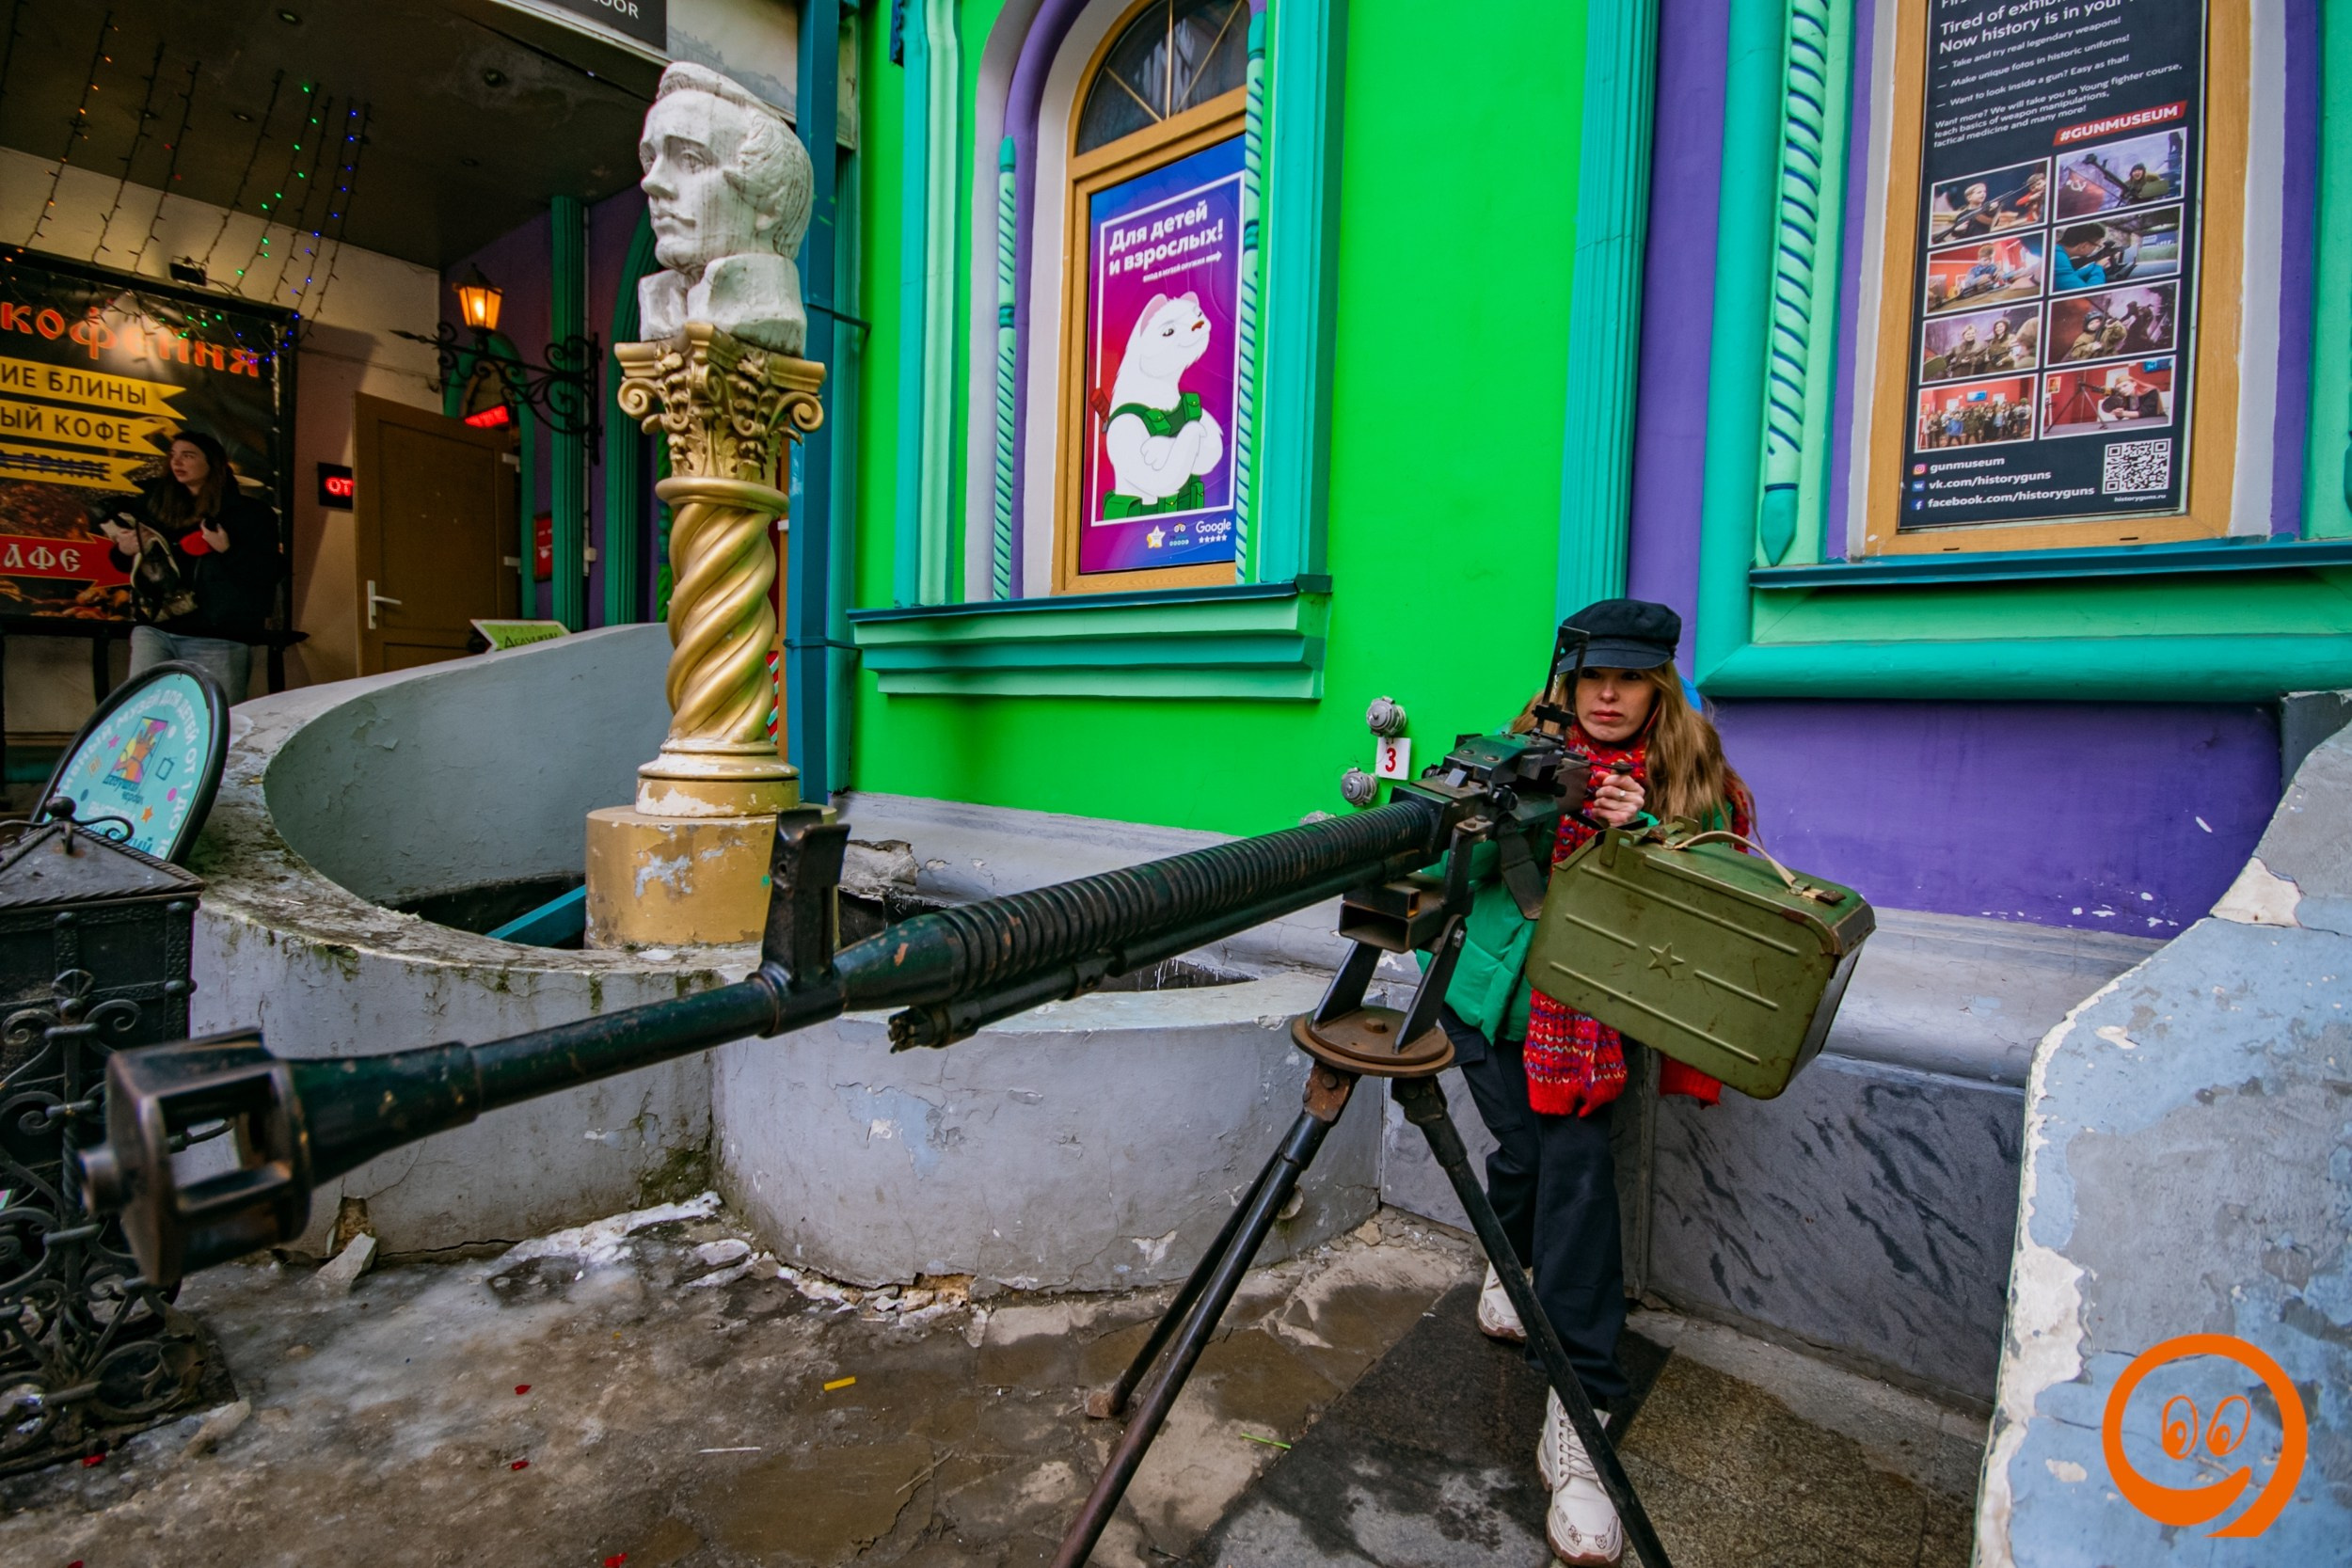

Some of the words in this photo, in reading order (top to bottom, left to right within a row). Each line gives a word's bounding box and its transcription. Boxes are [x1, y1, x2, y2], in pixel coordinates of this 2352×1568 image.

[592, 0, 640, 20] OR
[1940, 11, 1983, 36] Tired
[1987, 5, 2006, 23] of
[1939, 35, 1979, 55] Now
[1981, 17, 2041, 43] history
[2044, 11, 2058, 25] is
[2063, 7, 2079, 20] in
[1952, 57, 1972, 69] Take
[1974, 51, 1992, 62] and
[1993, 47, 2006, 57] try
[2007, 41, 2026, 54] real
[2026, 30, 2074, 48] legendary
[2075, 16, 2122, 35] weapons!
[1950, 74, 1977, 87] Make
[1979, 66, 2010, 81] unique
[2011, 58, 2034, 71] fotos
[2036, 55, 2045, 66] in
[2047, 46, 2082, 62] historic
[2085, 34, 2130, 53] uniforms!
[1935, 118, 1958, 129] Want
[1960, 109, 1988, 123] more?
[1991, 105, 2006, 115] We
[2008, 100, 2025, 110] will
[2026, 96, 2046, 107] take
[2048, 91, 2065, 103] you
[2079, 80, 2109, 93] Young
[2110, 71, 2144, 86] fighter
[2145, 63, 2183, 77] course,
[1949, 95, 1974, 106] Want
[1976, 91, 1985, 100] to
[1986, 86, 2006, 97] look
[2008, 77, 2036, 91] inside
[2045, 70, 2068, 84] gun?
[2070, 63, 2092, 75] Easy
[2094, 61, 2106, 70] as
[2107, 54, 2130, 67] that!
[1933, 135, 1965, 148] tactical
[1966, 124, 2009, 140] medicine
[2010, 119, 2029, 130] and
[2030, 111, 2056, 125] many
[2058, 104, 2087, 118] more!
[1934, 127, 1958, 138] teach
[1960, 121, 1987, 133] basics
[1989, 116, 1999, 125] of
[2000, 108, 2038, 122] weapon
[2040, 90, 2110, 112] manipulations,
[2059, 105, 2179, 142] #GUNMUSEUM
[1109, 229, 1147, 257] Для
[1150, 199, 1208, 242] детей
[1109, 259, 1120, 276] и
[1124, 217, 1224, 272] взрослых!
[49, 371, 147, 406] БЛИНЫ
[55, 408, 132, 445] КОФЕ
[1929, 470, 2052, 490] vk.com/historyguns
[1930, 455, 2006, 475] gunmuseum
[1927, 485, 2095, 509] facebook.com/historyguns
[2113, 493, 2167, 504] historyguns.ru
[1196, 518, 1232, 533] Google
[1385, 747, 1397, 773] 3
